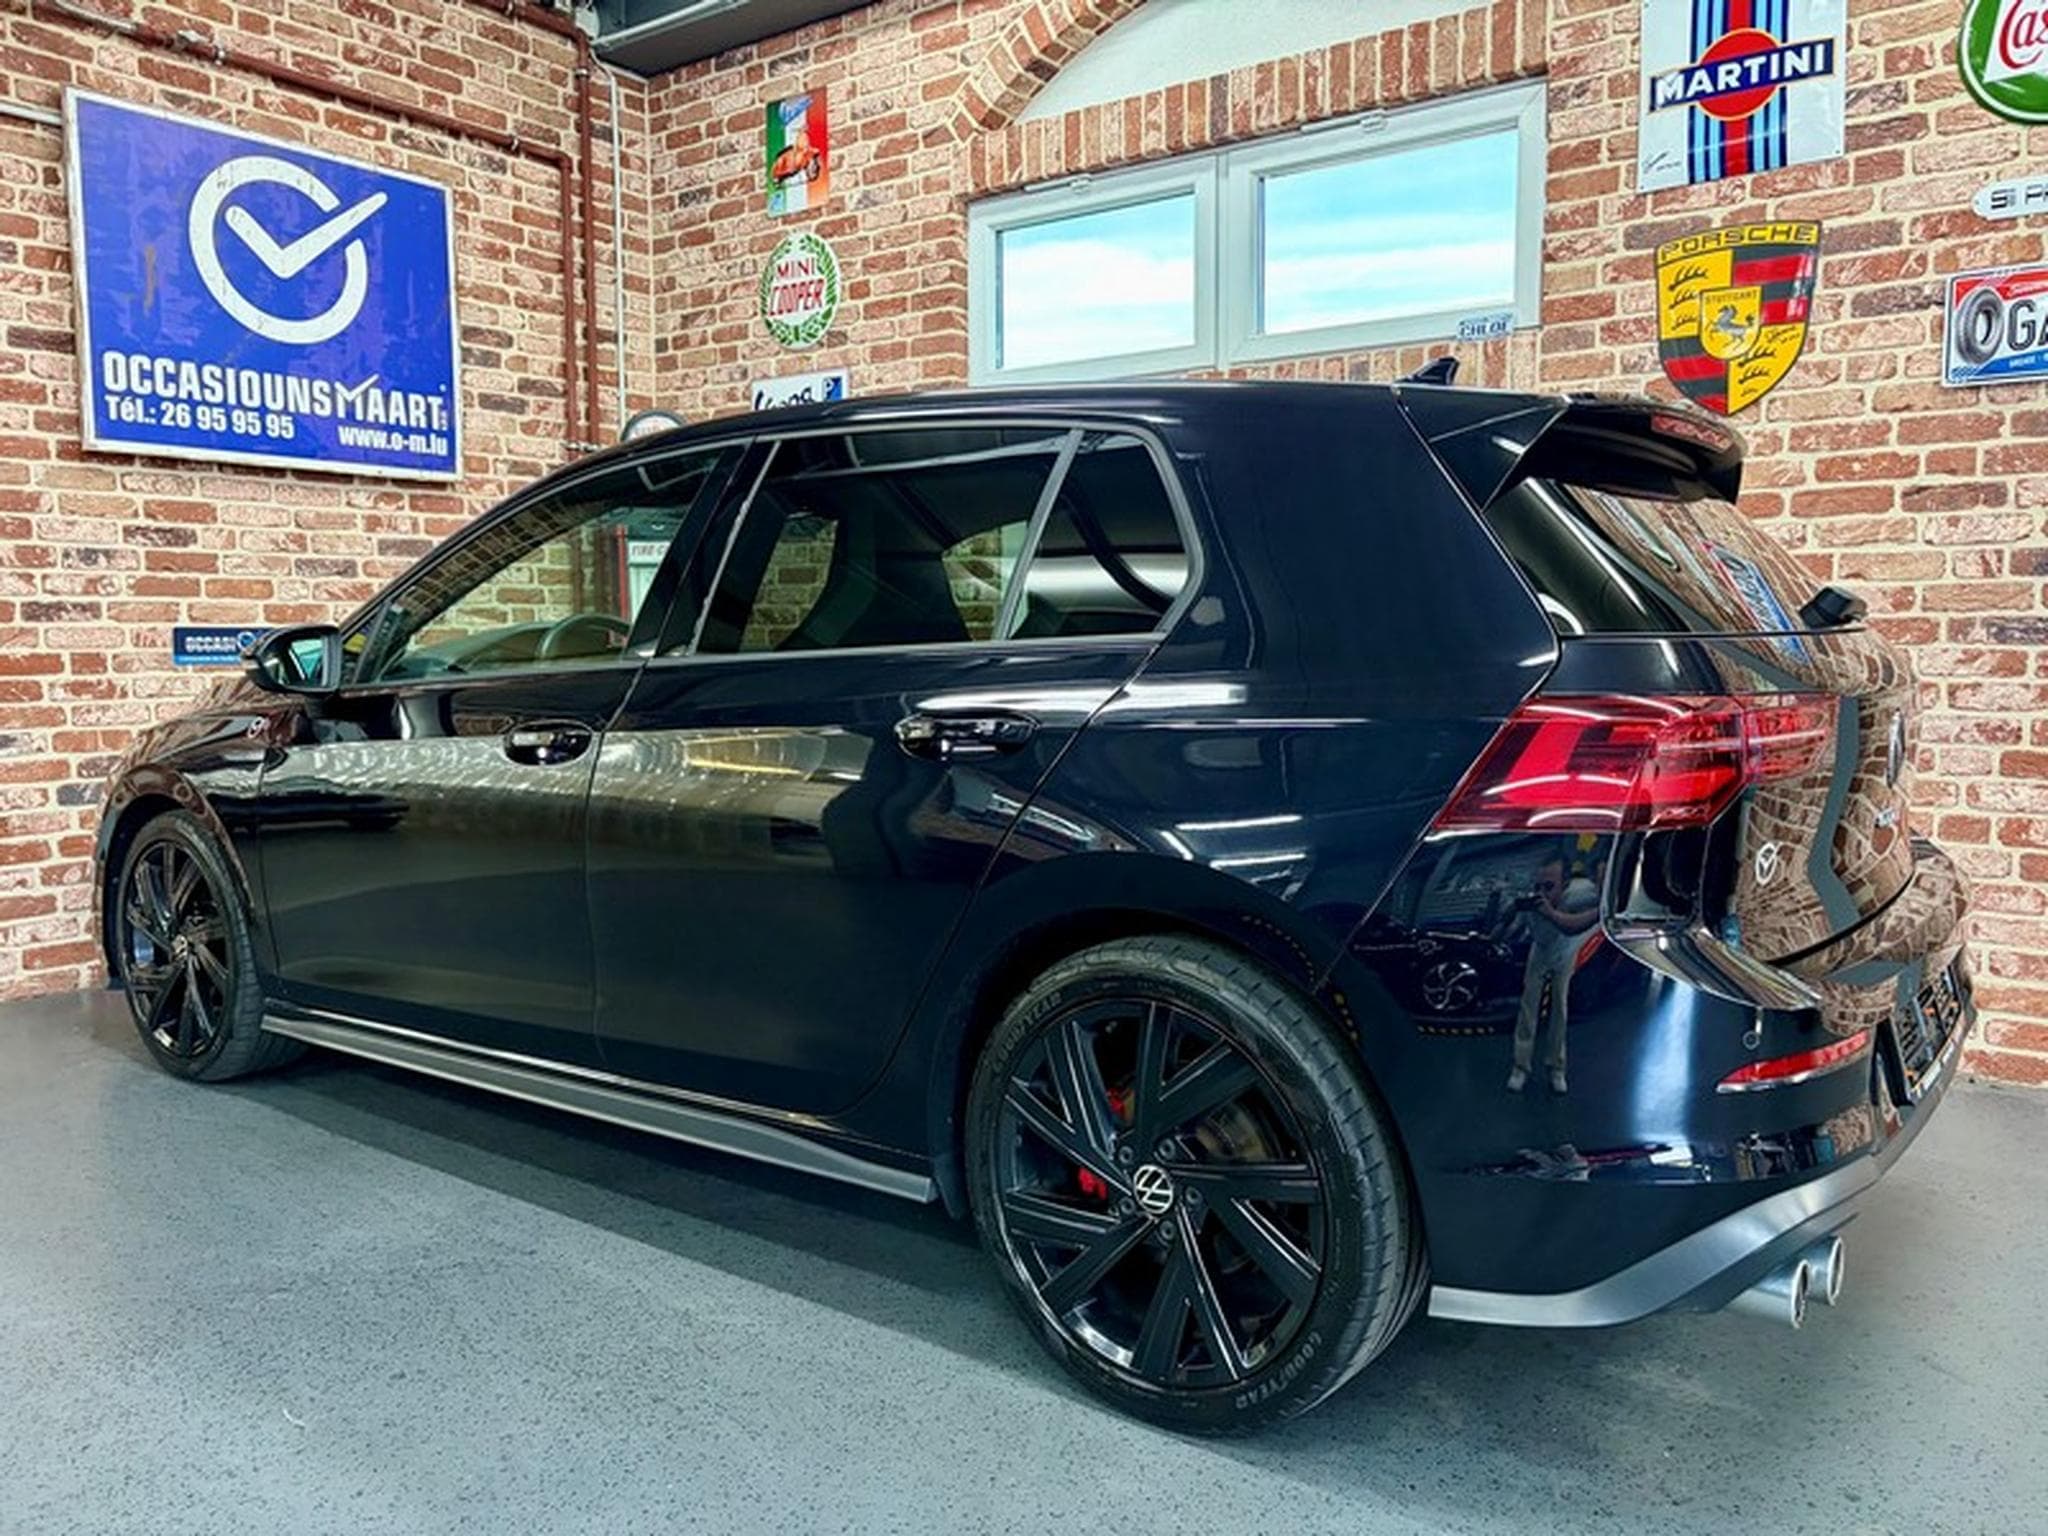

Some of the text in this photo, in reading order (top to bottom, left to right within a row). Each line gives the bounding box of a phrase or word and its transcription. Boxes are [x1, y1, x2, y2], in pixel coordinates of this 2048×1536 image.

[1655, 42, 1826, 106] MARTINI
[1660, 224, 1813, 261] PORSCHE
[776, 256, 816, 278] MINI
[768, 278, 825, 317] COOPER
[104, 394, 296, 440] Tél.: 26 95 95 95
[337, 425, 448, 457] www.o-m.lu
